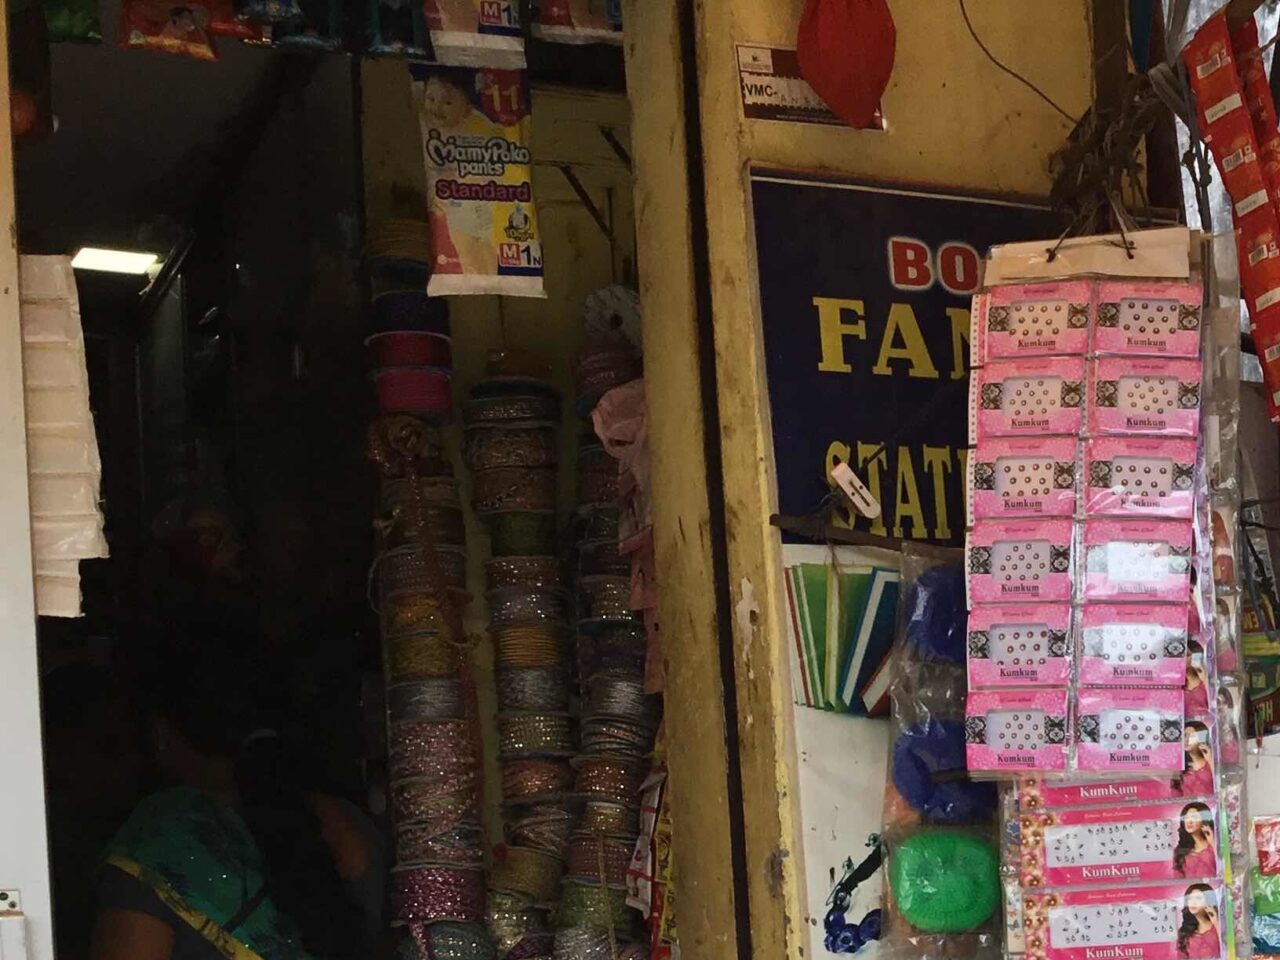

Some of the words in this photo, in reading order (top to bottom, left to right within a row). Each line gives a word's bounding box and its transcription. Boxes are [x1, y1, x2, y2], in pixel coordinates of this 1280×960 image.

[458, 160, 504, 177] pants
[435, 178, 531, 202] Standard
[1018, 339, 1056, 349] Kumkum
[1126, 337, 1167, 348] Kumkum
[1011, 418, 1050, 428] Kumkum
[1126, 418, 1167, 428] Kumkum
[1003, 499, 1043, 509] Kumkum
[1001, 583, 1040, 593] Kumkum
[999, 667, 1038, 678] Kumkum
[1112, 667, 1153, 677] Kumkum
[997, 753, 1036, 764] Kumkum
[1109, 753, 1150, 763] Kumkum
[1080, 785, 1138, 798] KumKum
[1082, 866, 1140, 879] KumKum
[1085, 946, 1144, 960] KumKum
